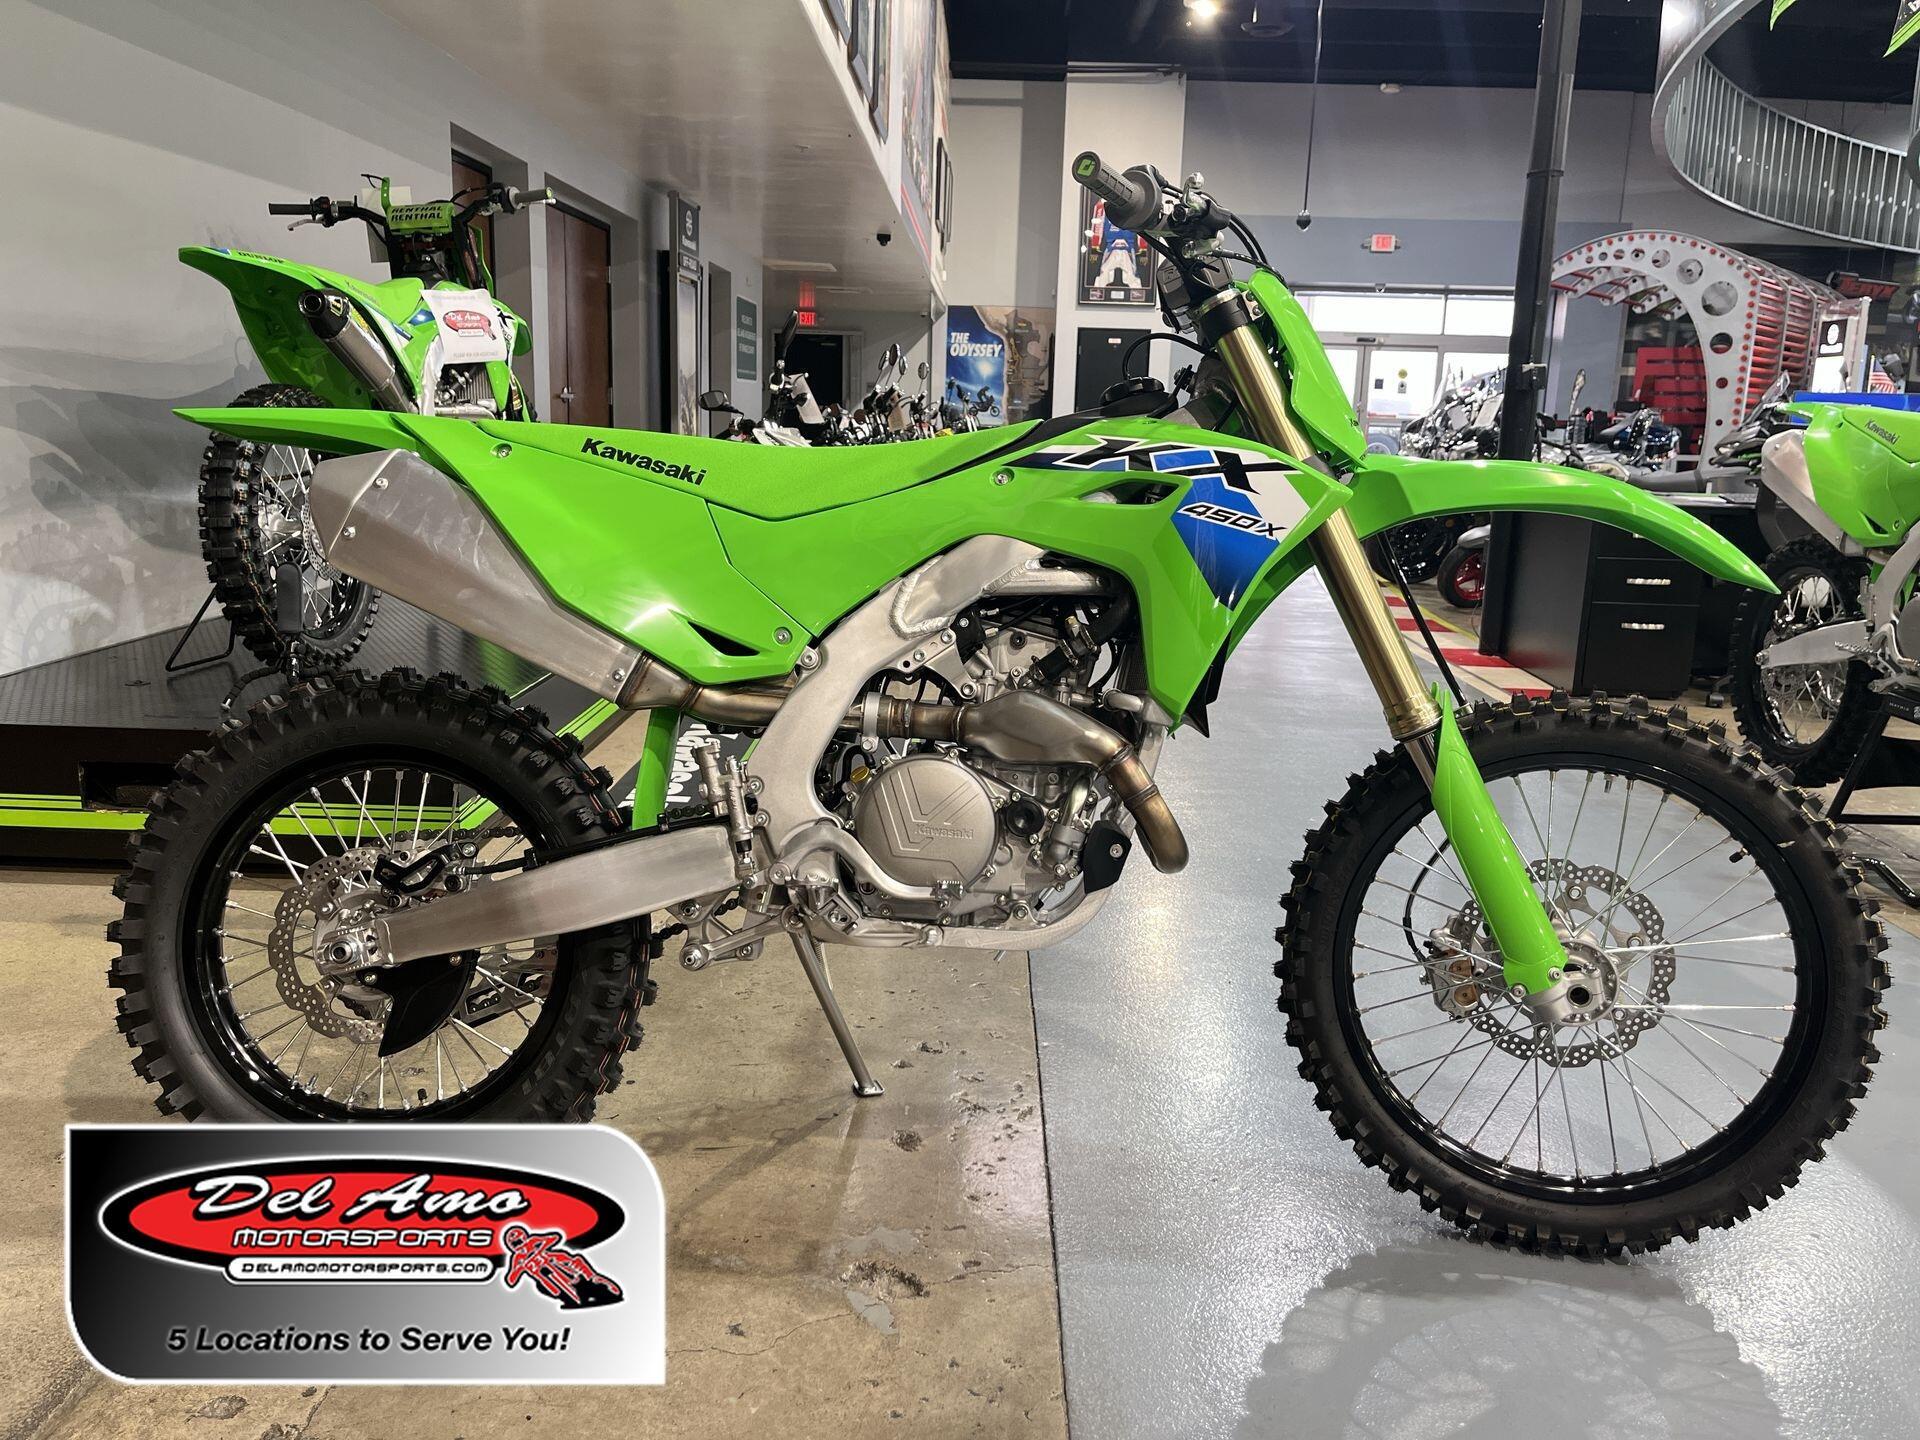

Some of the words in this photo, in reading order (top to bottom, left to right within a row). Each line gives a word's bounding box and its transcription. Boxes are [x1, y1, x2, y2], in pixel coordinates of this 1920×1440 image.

[391, 212, 443, 222] RENTHAL
[799, 311, 816, 326] EXIT
[950, 332, 971, 344] THE
[950, 343, 1003, 357] ODYSSEY
[581, 438, 707, 486] Kawasaki
[1179, 502, 1288, 541] 450X
[914, 823, 974, 840] Kawasaki
